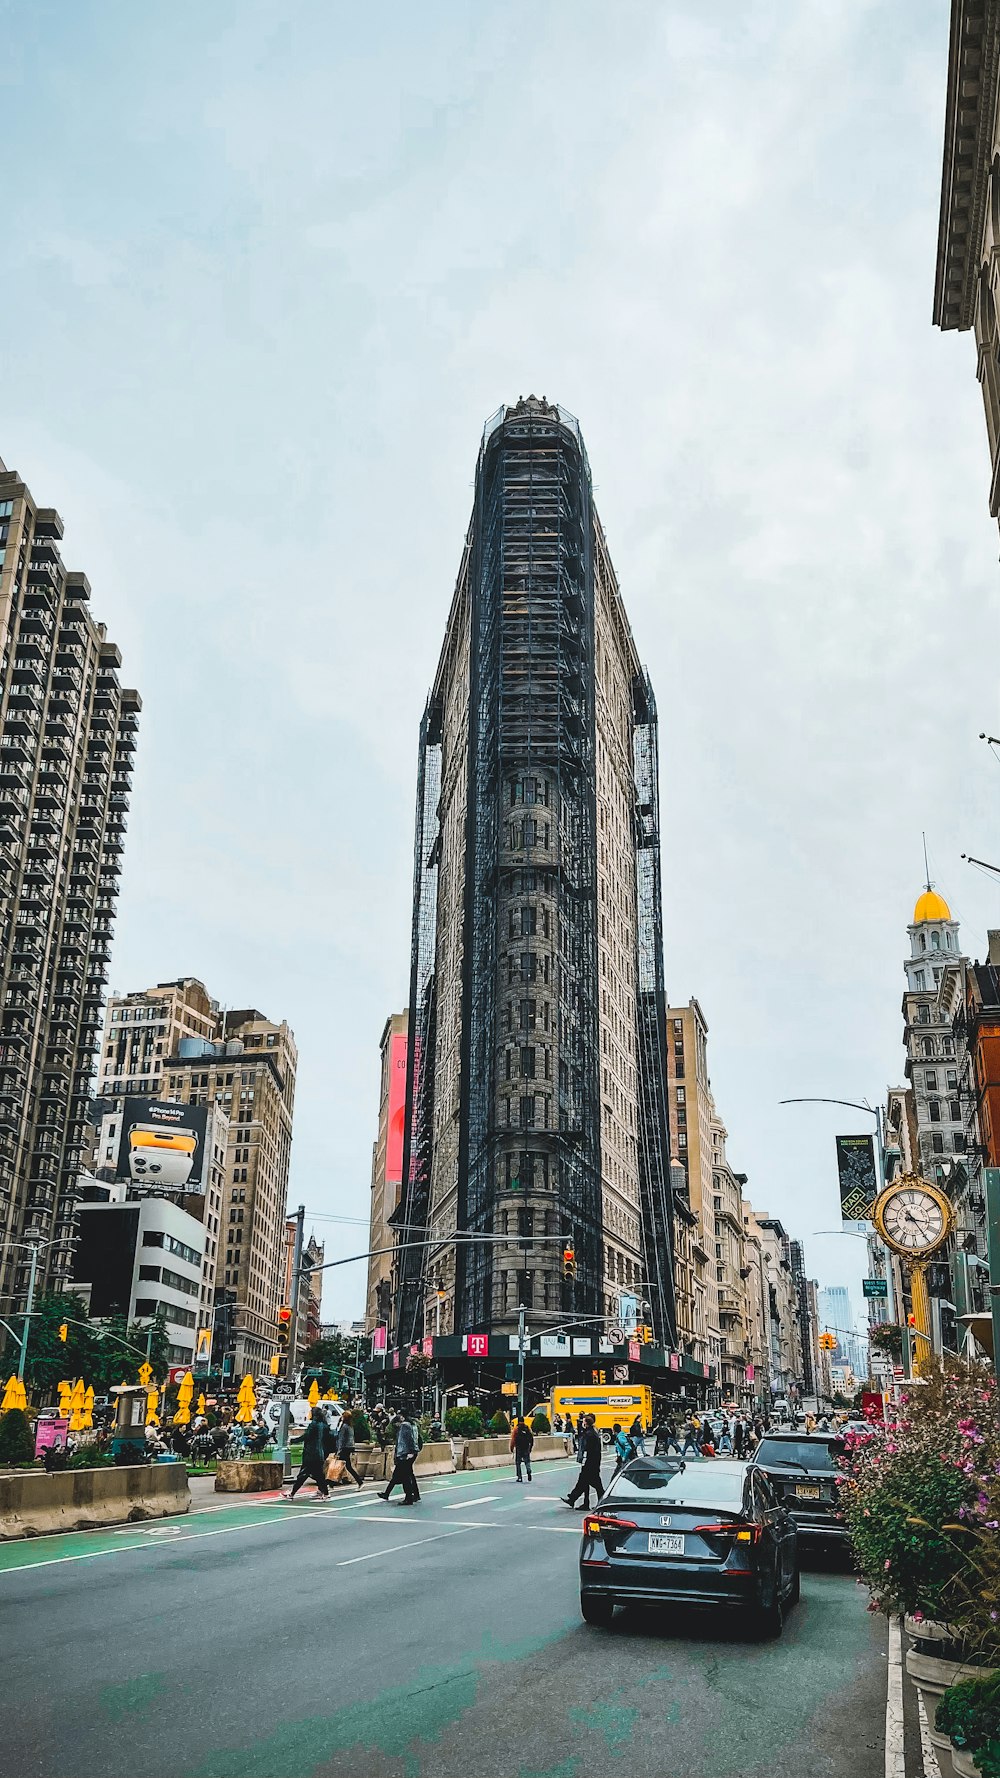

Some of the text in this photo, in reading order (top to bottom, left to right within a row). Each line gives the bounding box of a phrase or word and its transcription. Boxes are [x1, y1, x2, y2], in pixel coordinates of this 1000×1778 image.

[842, 1193, 862, 1210] MAD.
[850, 1206, 865, 1218] SQ.
[472, 1338, 484, 1353] T
